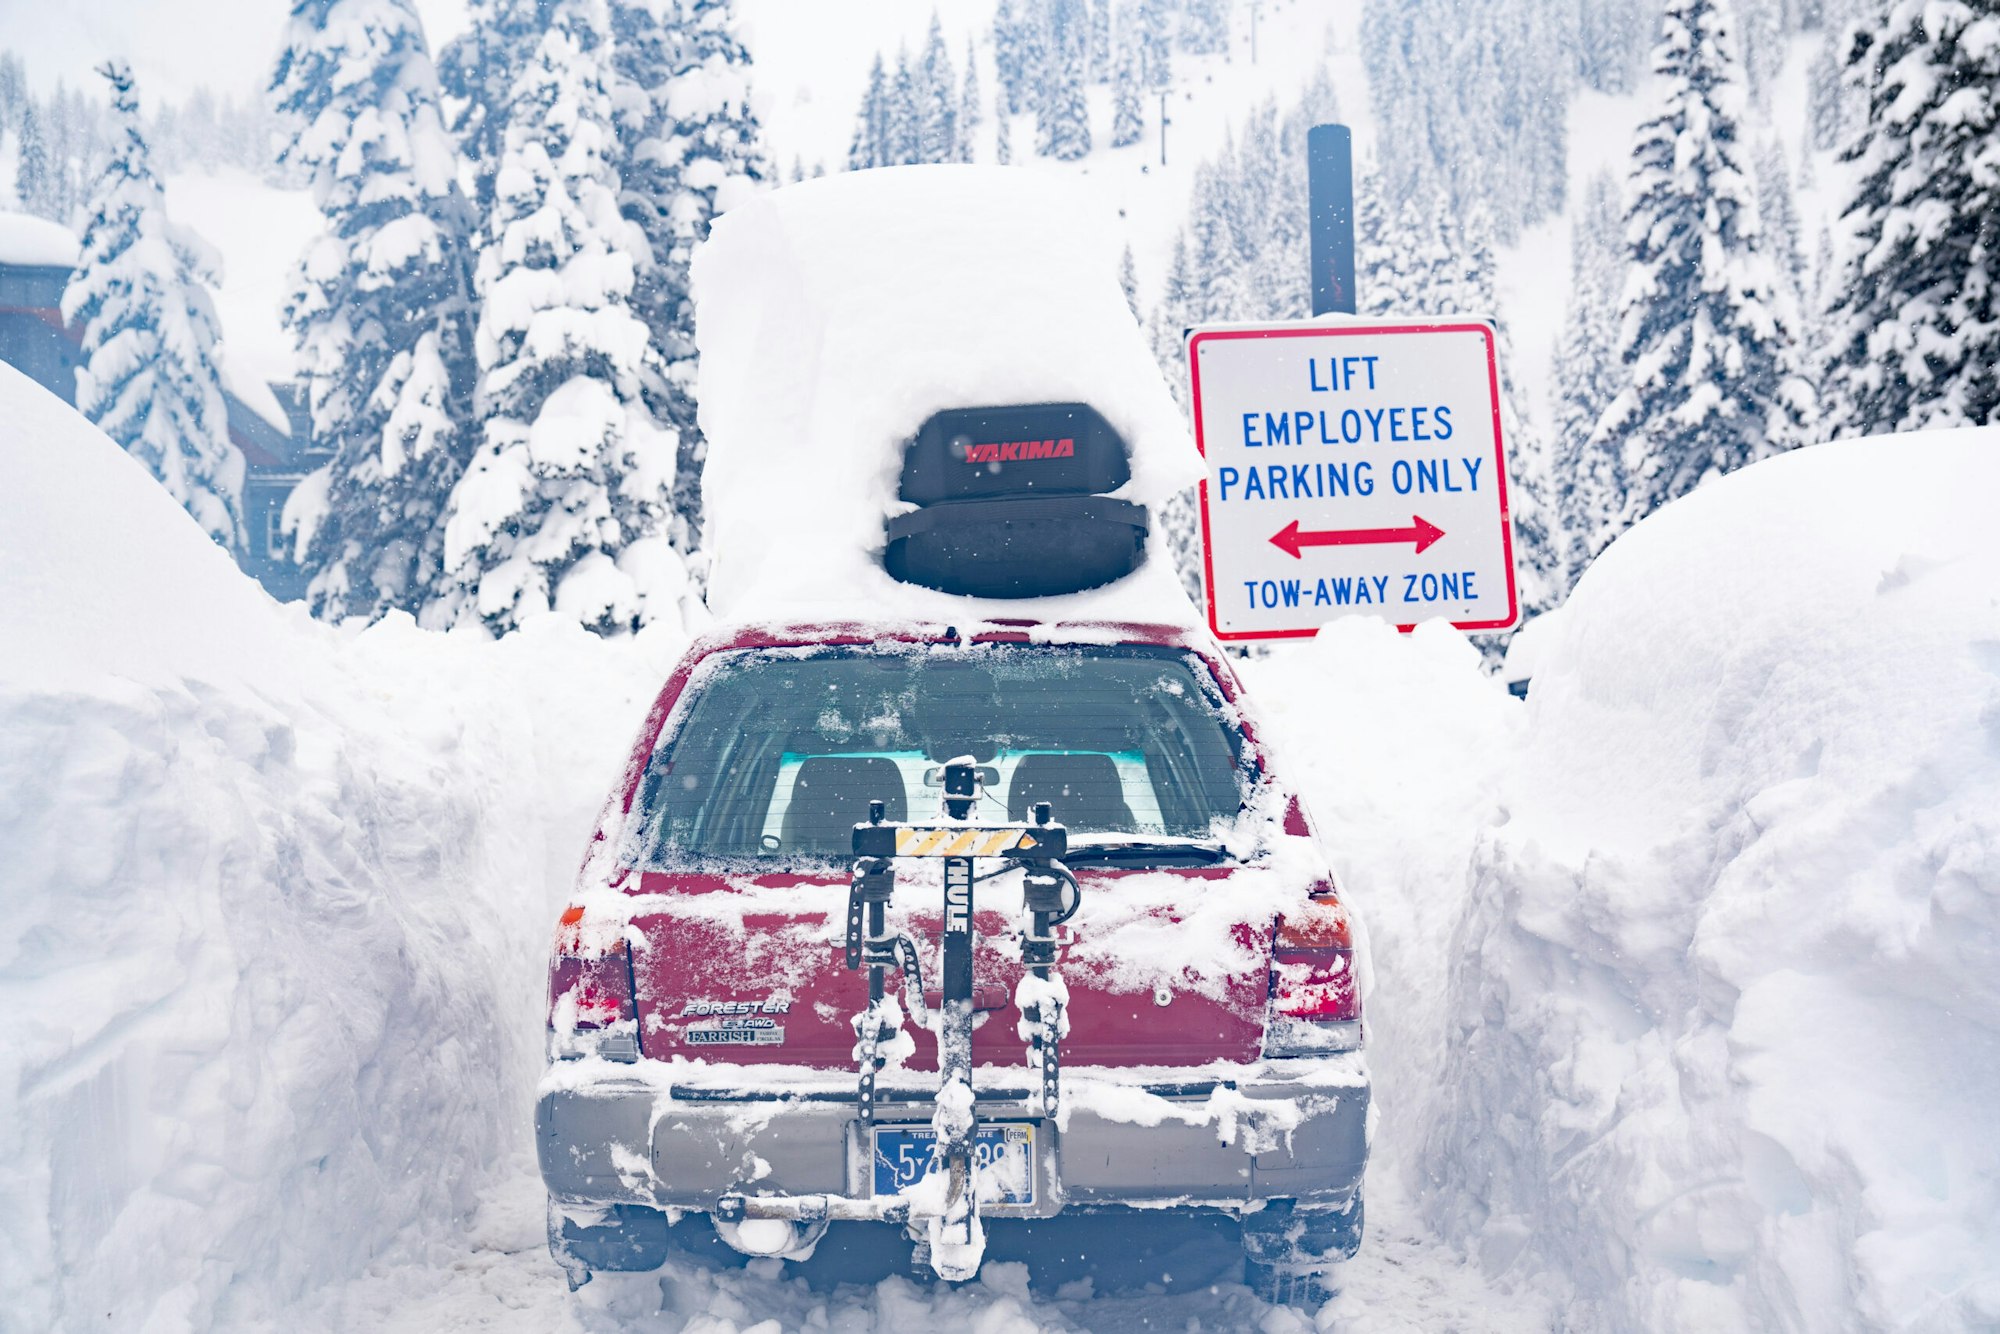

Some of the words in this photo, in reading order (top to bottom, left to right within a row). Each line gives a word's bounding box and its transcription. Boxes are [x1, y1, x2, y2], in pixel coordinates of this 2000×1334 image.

[1309, 356, 1379, 392] LIFT
[1242, 406, 1453, 448] EMPLOYEES
[963, 438, 1075, 464] YAKIMA
[1218, 461, 1375, 501] PARKING
[1392, 457, 1483, 495] ONLY
[1244, 575, 1389, 609] TOW-AWAY
[1403, 572, 1479, 602] ZONE
[682, 1001, 791, 1016] FORESTER
[744, 1018, 775, 1029] AWD
[692, 1031, 751, 1042] FARRISH
